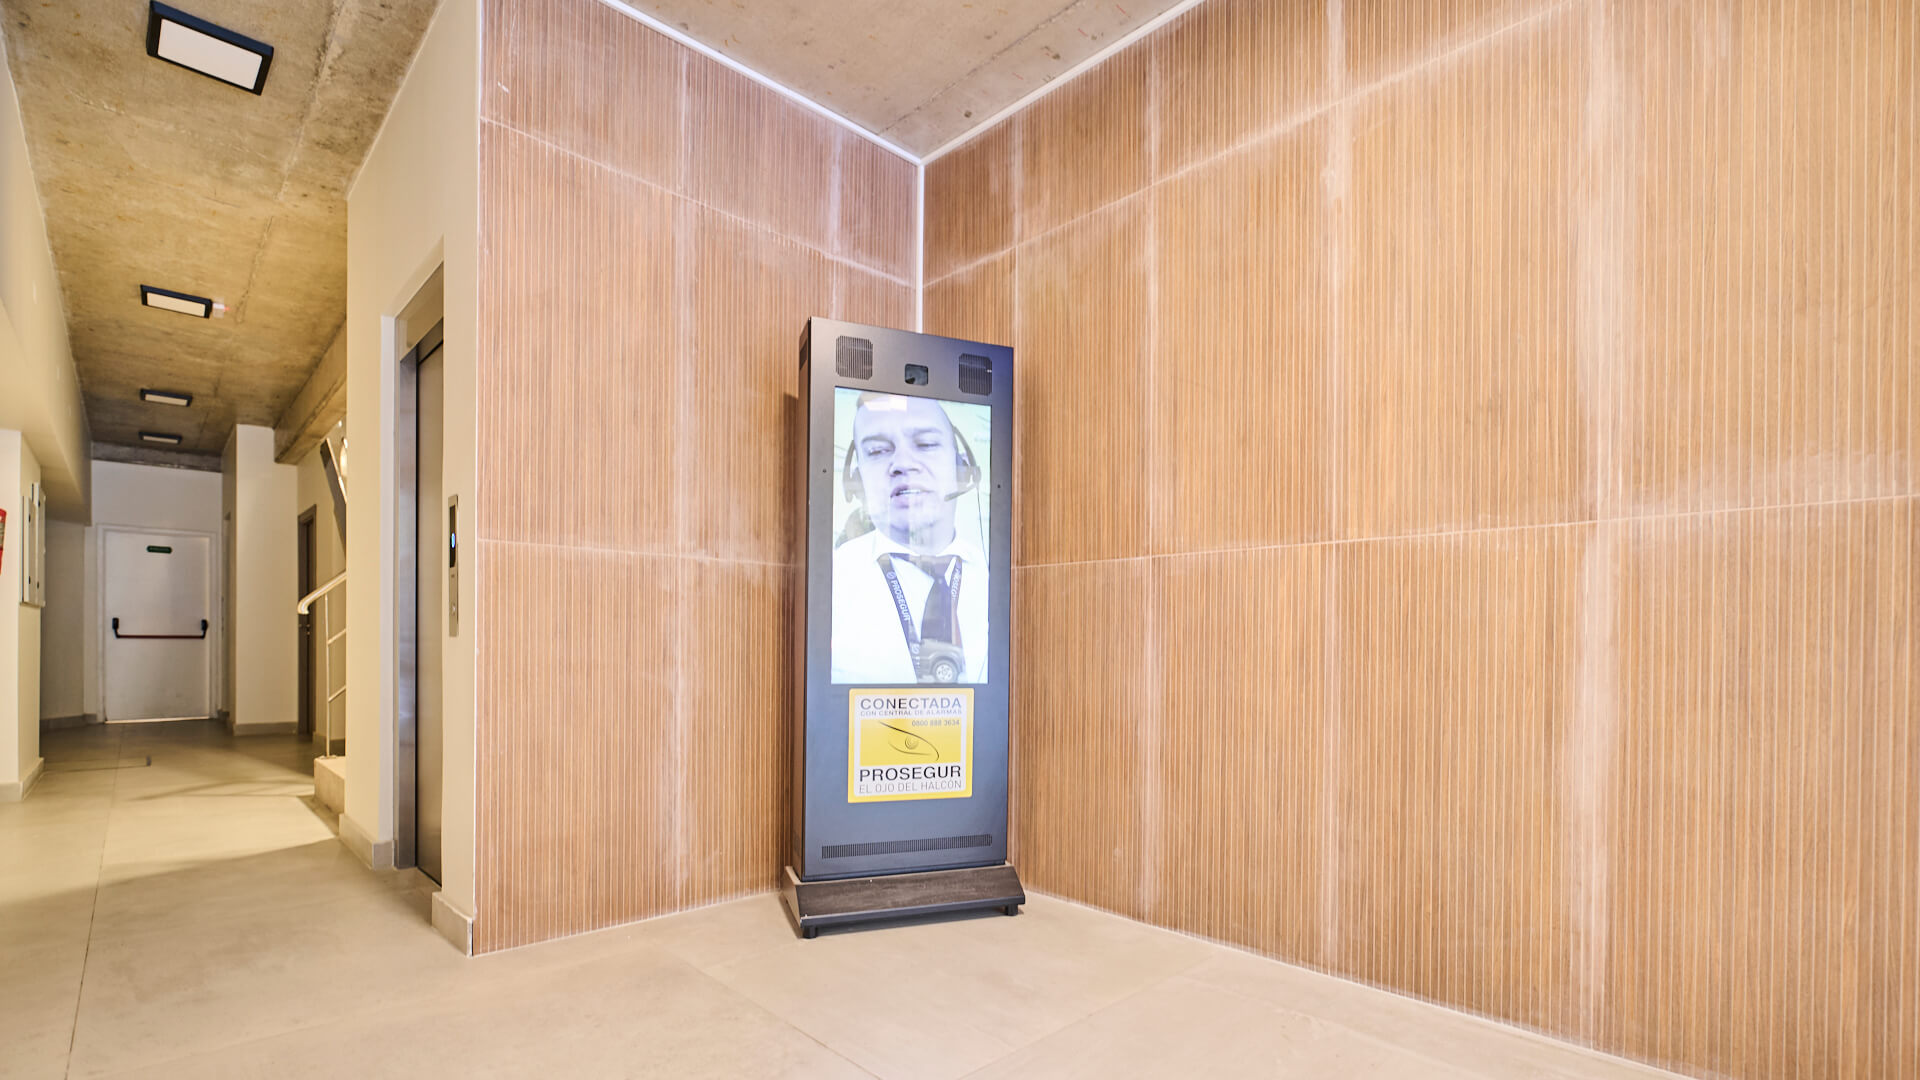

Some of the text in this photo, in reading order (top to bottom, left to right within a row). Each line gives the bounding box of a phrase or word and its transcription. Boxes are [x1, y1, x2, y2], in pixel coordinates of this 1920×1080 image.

[891, 580, 910, 621] PROSEGUR
[860, 698, 962, 710] CONECTADA
[859, 765, 961, 782] PROSEGUR
[859, 784, 872, 794] EL
[875, 783, 895, 793] OJO
[898, 782, 917, 791] DEL
